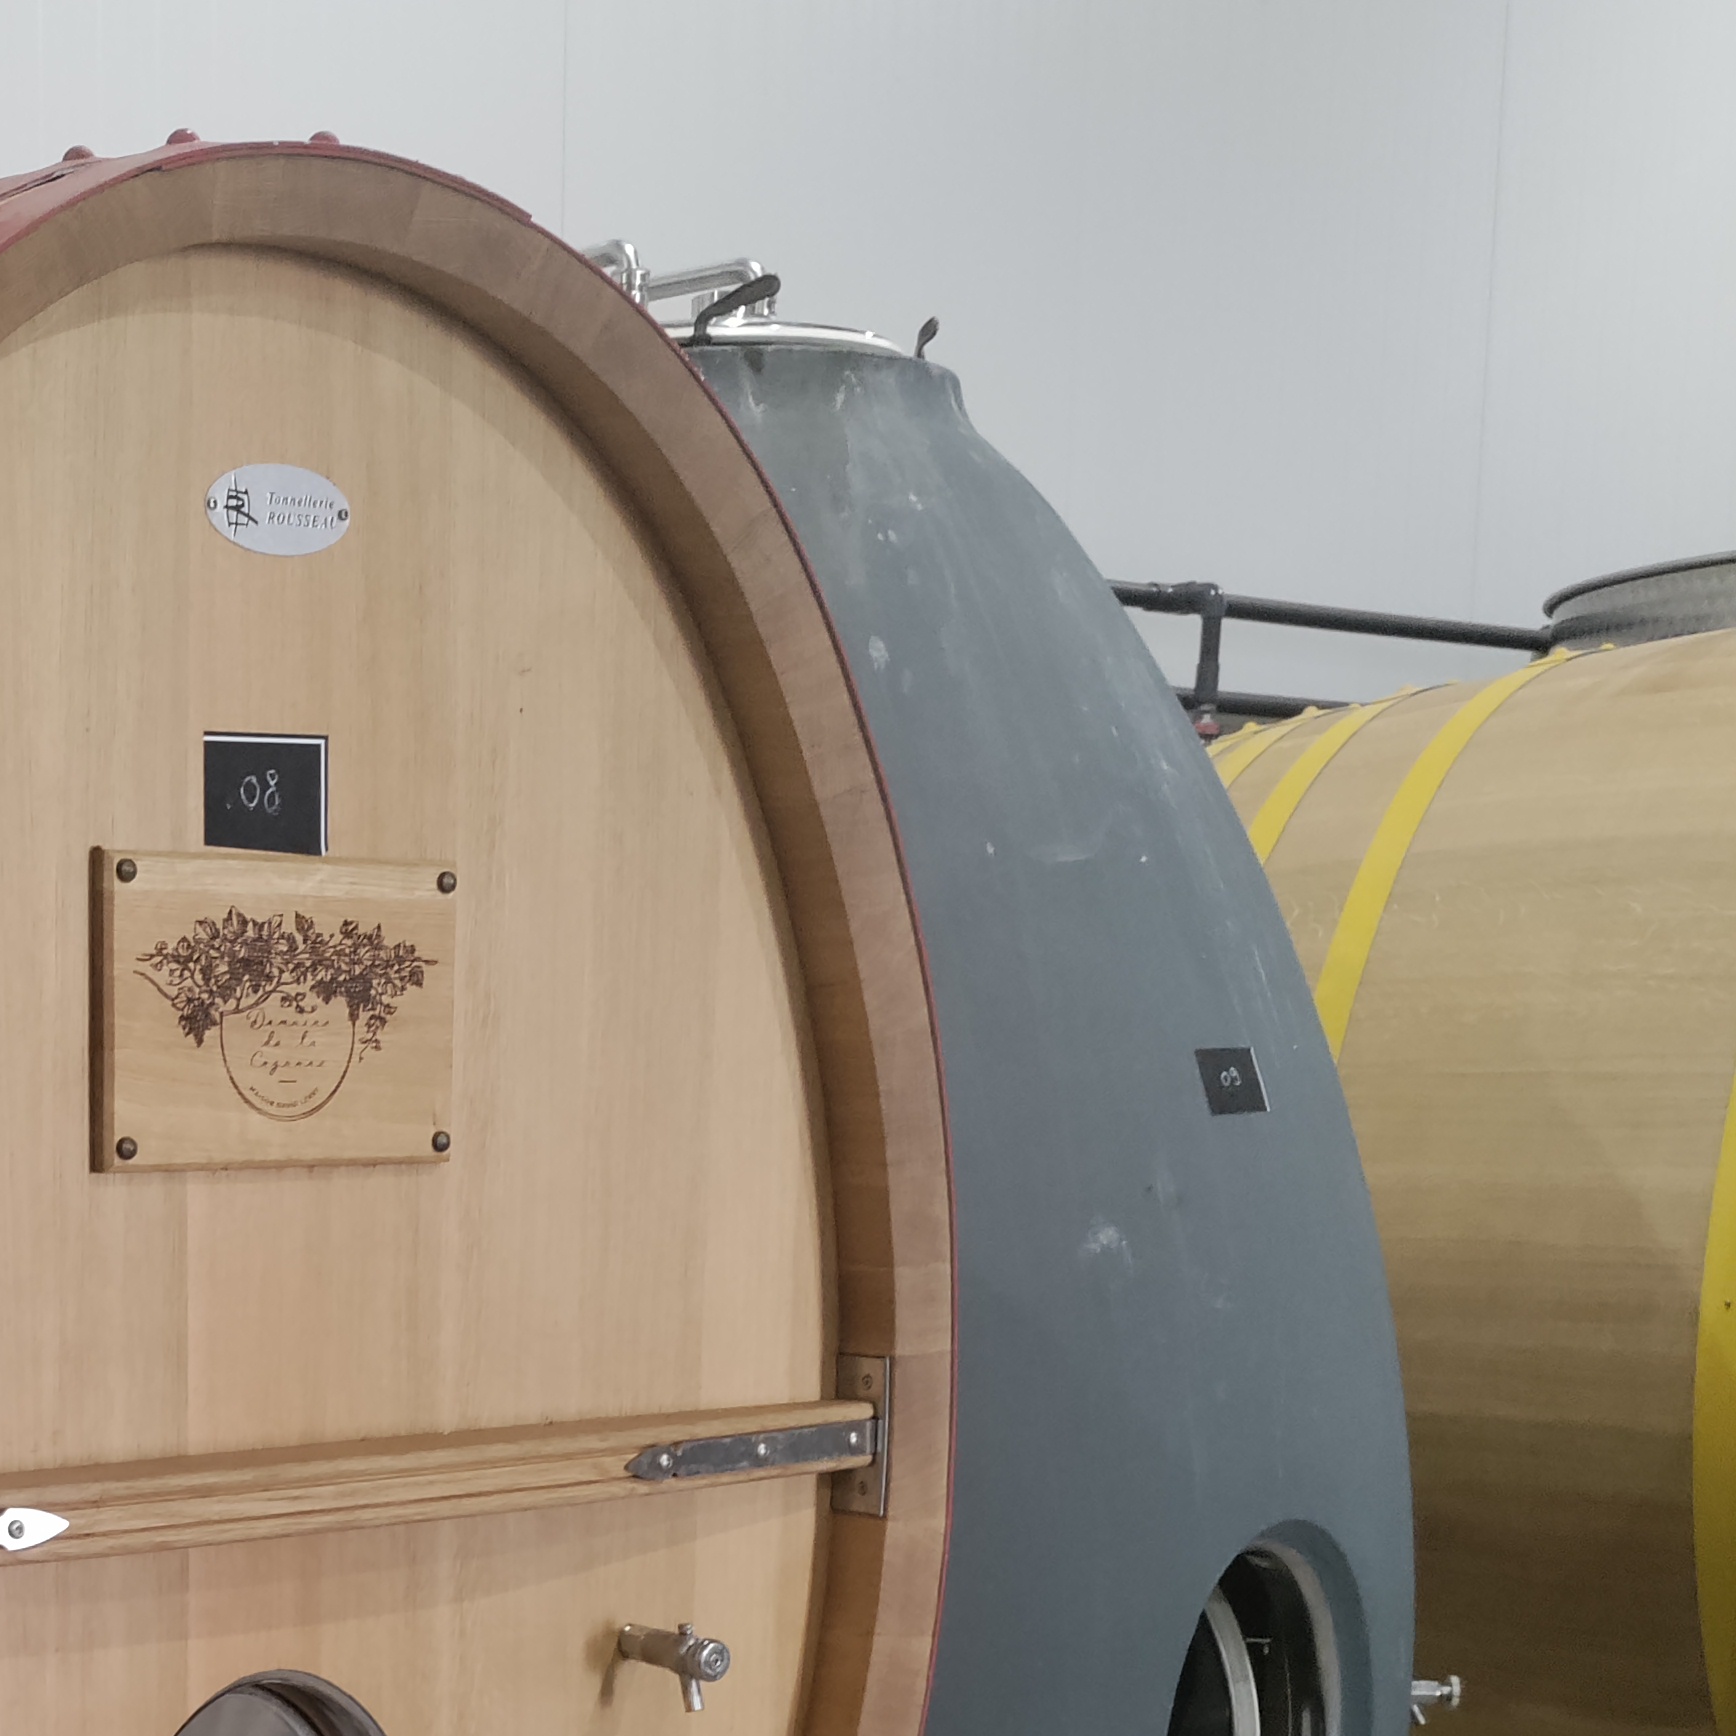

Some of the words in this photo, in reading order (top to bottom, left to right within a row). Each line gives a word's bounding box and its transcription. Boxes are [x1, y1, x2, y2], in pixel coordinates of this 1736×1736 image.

[266, 491, 335, 511] Tonnellerie
[266, 510, 338, 531] ROUSSEAU
[240, 769, 281, 815] 08
[1220, 1066, 1242, 1087] 09
